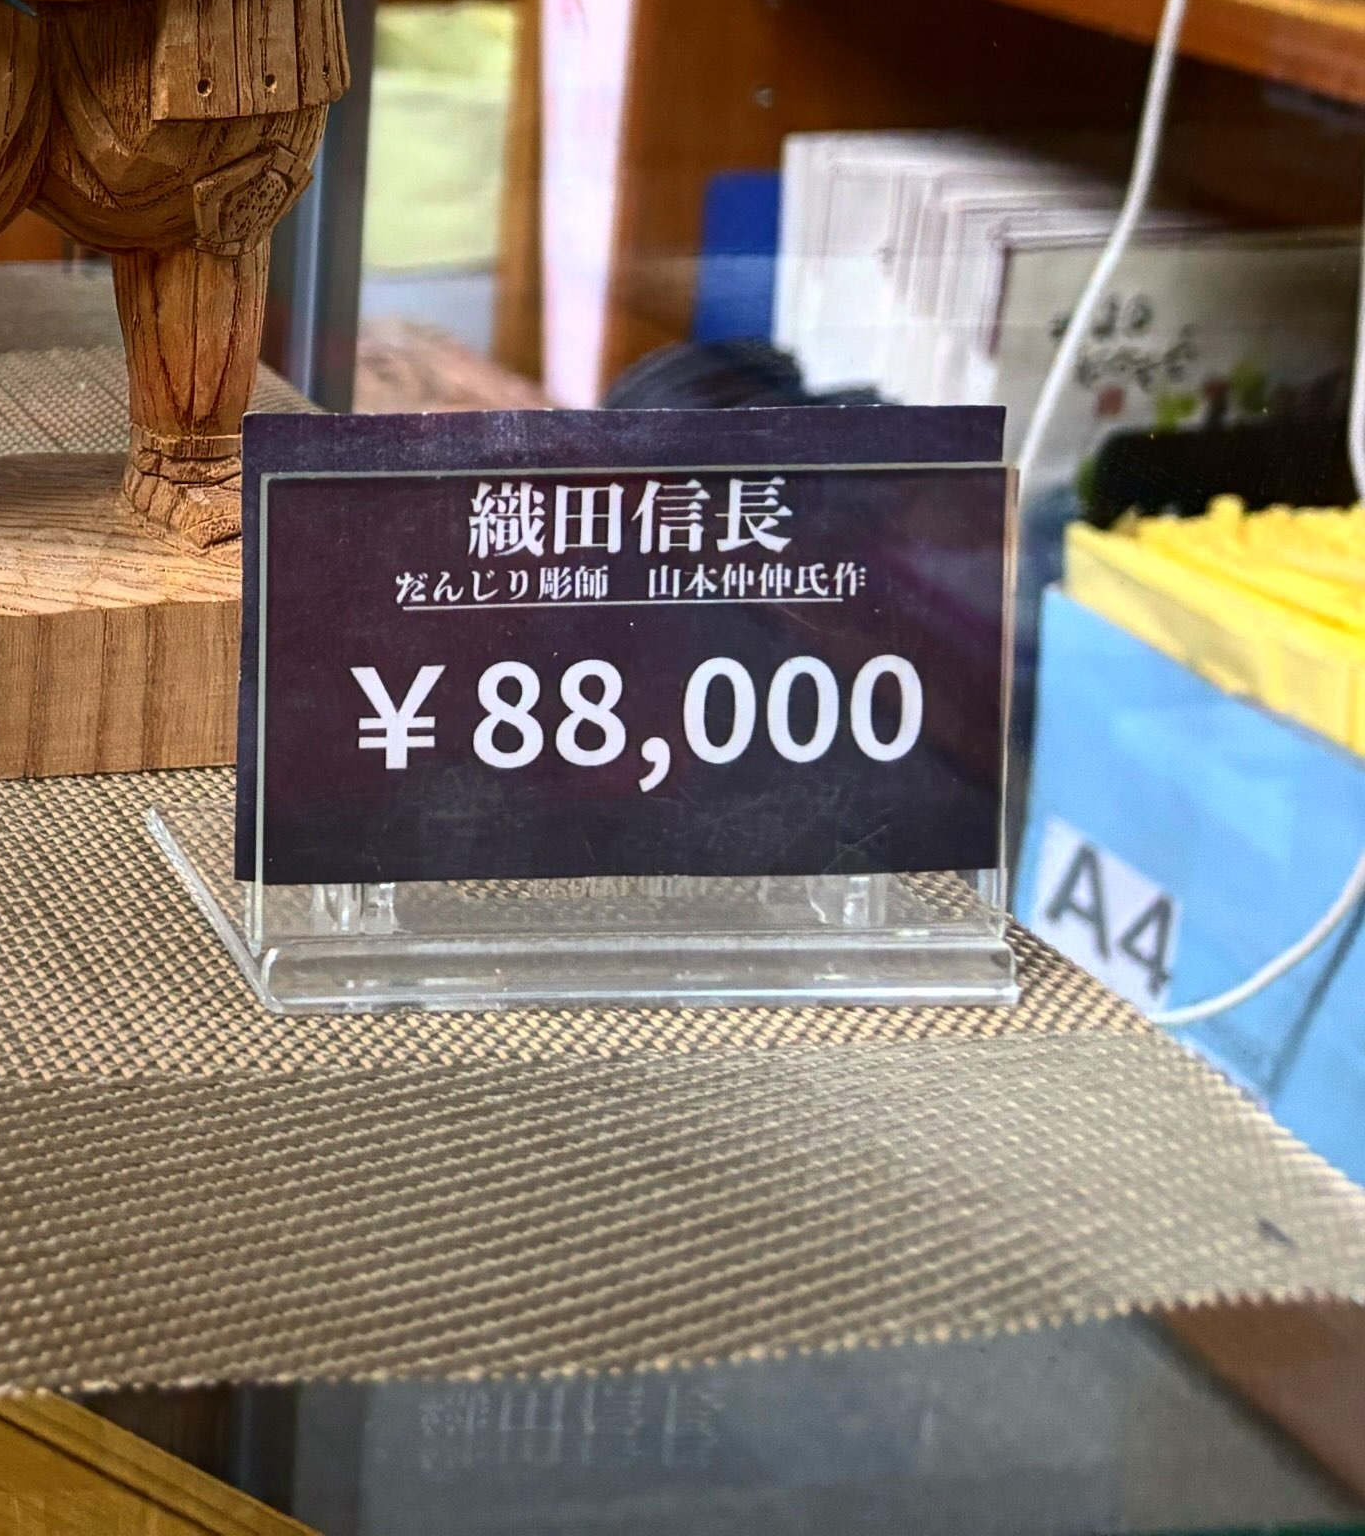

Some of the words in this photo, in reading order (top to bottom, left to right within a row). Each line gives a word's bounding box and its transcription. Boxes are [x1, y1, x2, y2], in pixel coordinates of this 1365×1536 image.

[468, 476, 794, 559] 織田信長
[395, 566, 609, 603] だんじり彫師
[350, 655, 925, 793] ¥88,000
[1046, 844, 1171, 996] A4
